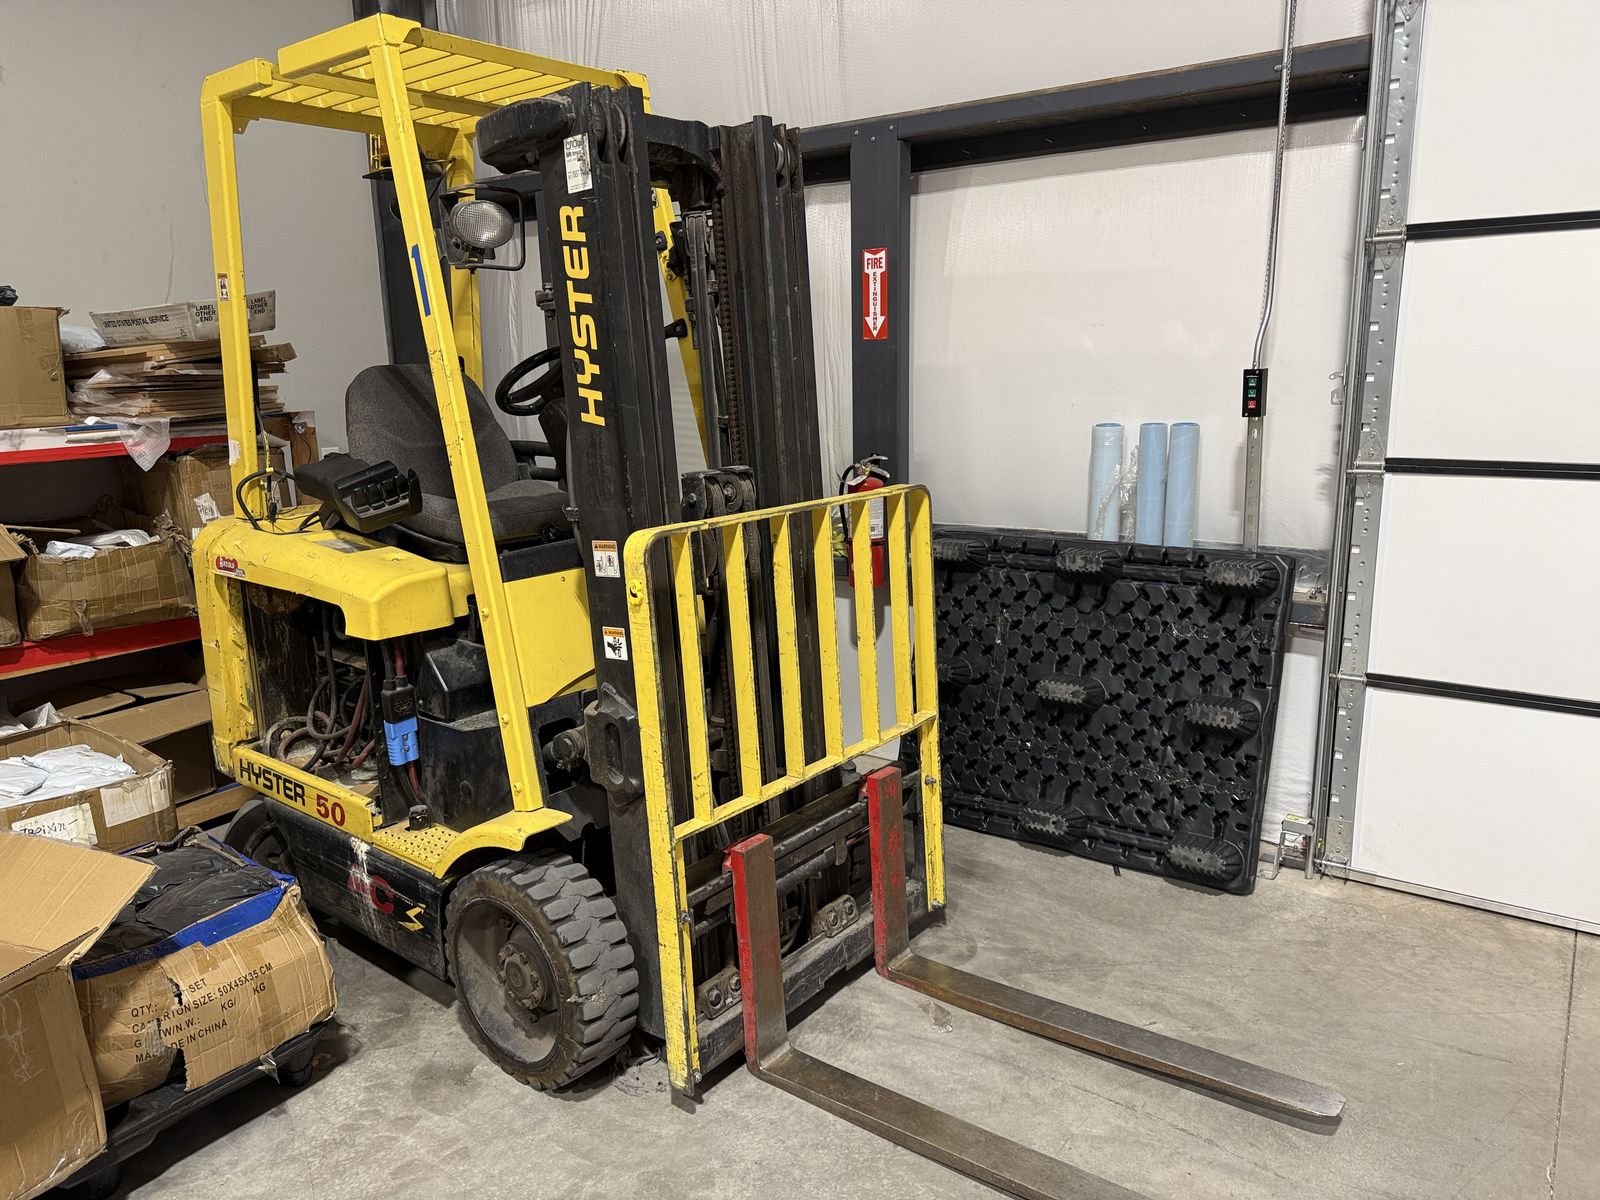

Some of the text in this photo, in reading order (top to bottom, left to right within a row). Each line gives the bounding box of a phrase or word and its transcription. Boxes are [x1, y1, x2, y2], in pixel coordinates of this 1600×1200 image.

[867, 257, 883, 269] FIRE
[250, 296, 267, 304] LABEL
[250, 302, 268, 310] OTHER
[195, 304, 215, 312] LABEL
[103, 313, 170, 328] UNITED STATES POSTAL SERVICE
[200, 315, 213, 323] END
[559, 205, 606, 427] HYSTER
[239, 758, 346, 827] HYSTER 50
[193, 991, 217, 1010] SIZE:
[217, 970, 260, 997] 50X45X35
[259, 962, 274, 977] CM
[253, 982, 267, 997] KG
[131, 1002, 159, 1018] QTY.:
[186, 1033, 197, 1045] IN
[199, 1018, 228, 1038] CHINA
